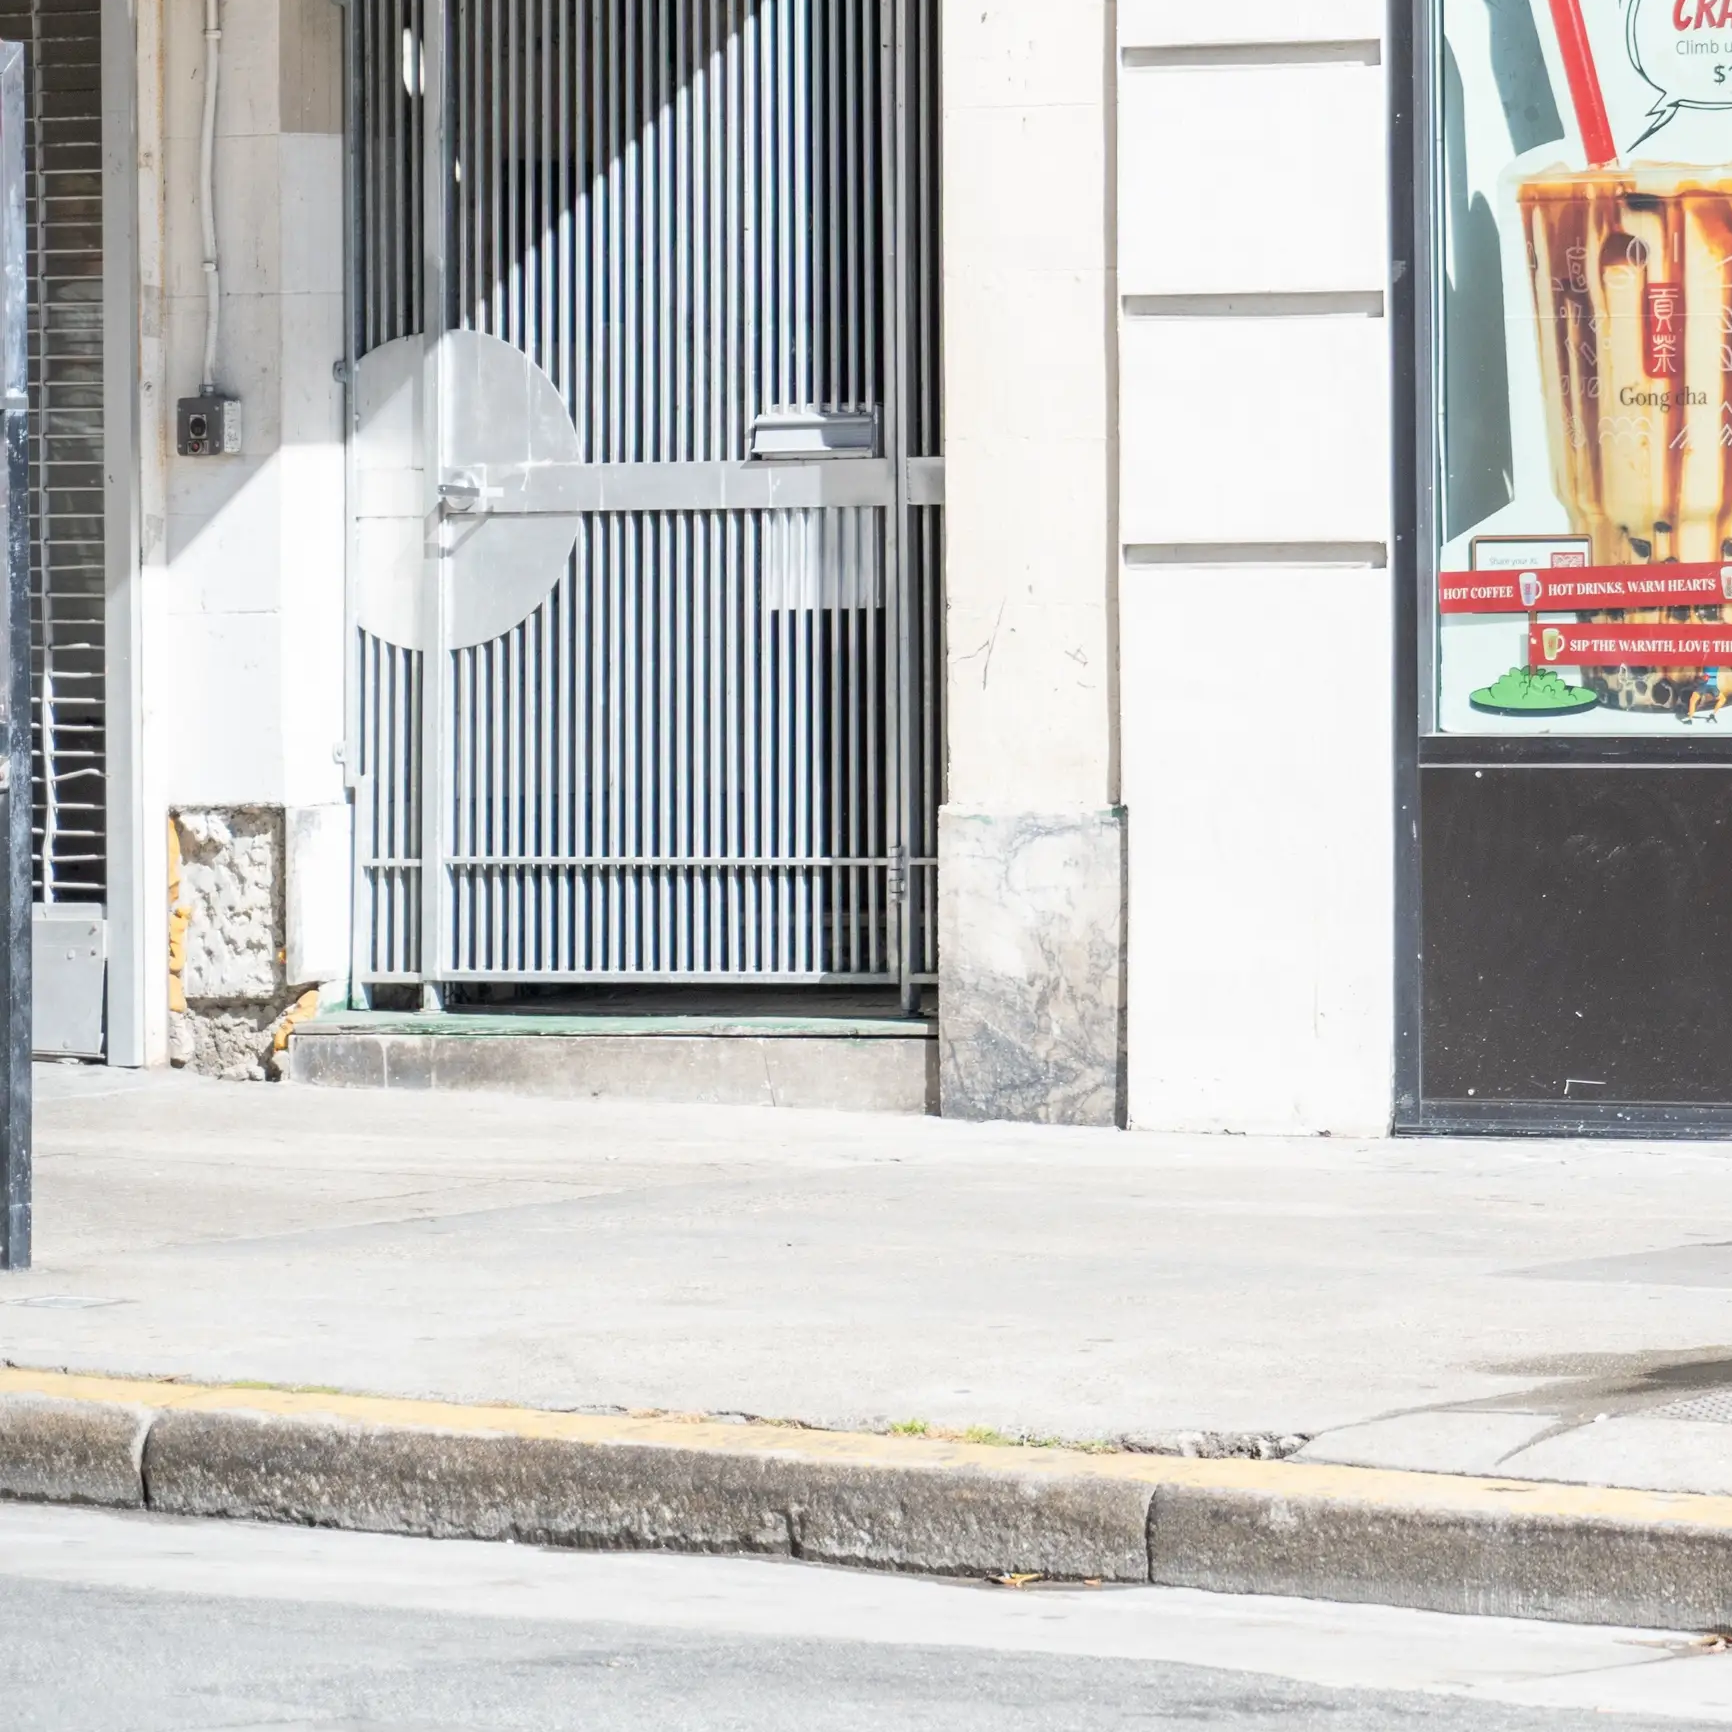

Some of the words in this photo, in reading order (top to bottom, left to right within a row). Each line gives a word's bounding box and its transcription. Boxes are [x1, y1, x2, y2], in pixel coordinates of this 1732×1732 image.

[1675, 37, 1719, 56] Climb
[1620, 386, 1671, 414] Gong
[1675, 386, 1708, 406] cha
[1443, 588, 1468, 600] HOT
[1470, 586, 1513, 599] COFFEE
[1548, 584, 1575, 597] HOT
[1576, 582, 1626, 596] DRINKS,
[1628, 580, 1666, 593] WARM
[1667, 578, 1716, 592] HEARTS
[1569, 639, 1590, 652] SIP
[1591, 639, 1616, 652] THE
[1618, 639, 1676, 654] WARMTH,
[1678, 639, 1710, 653] LOVE
